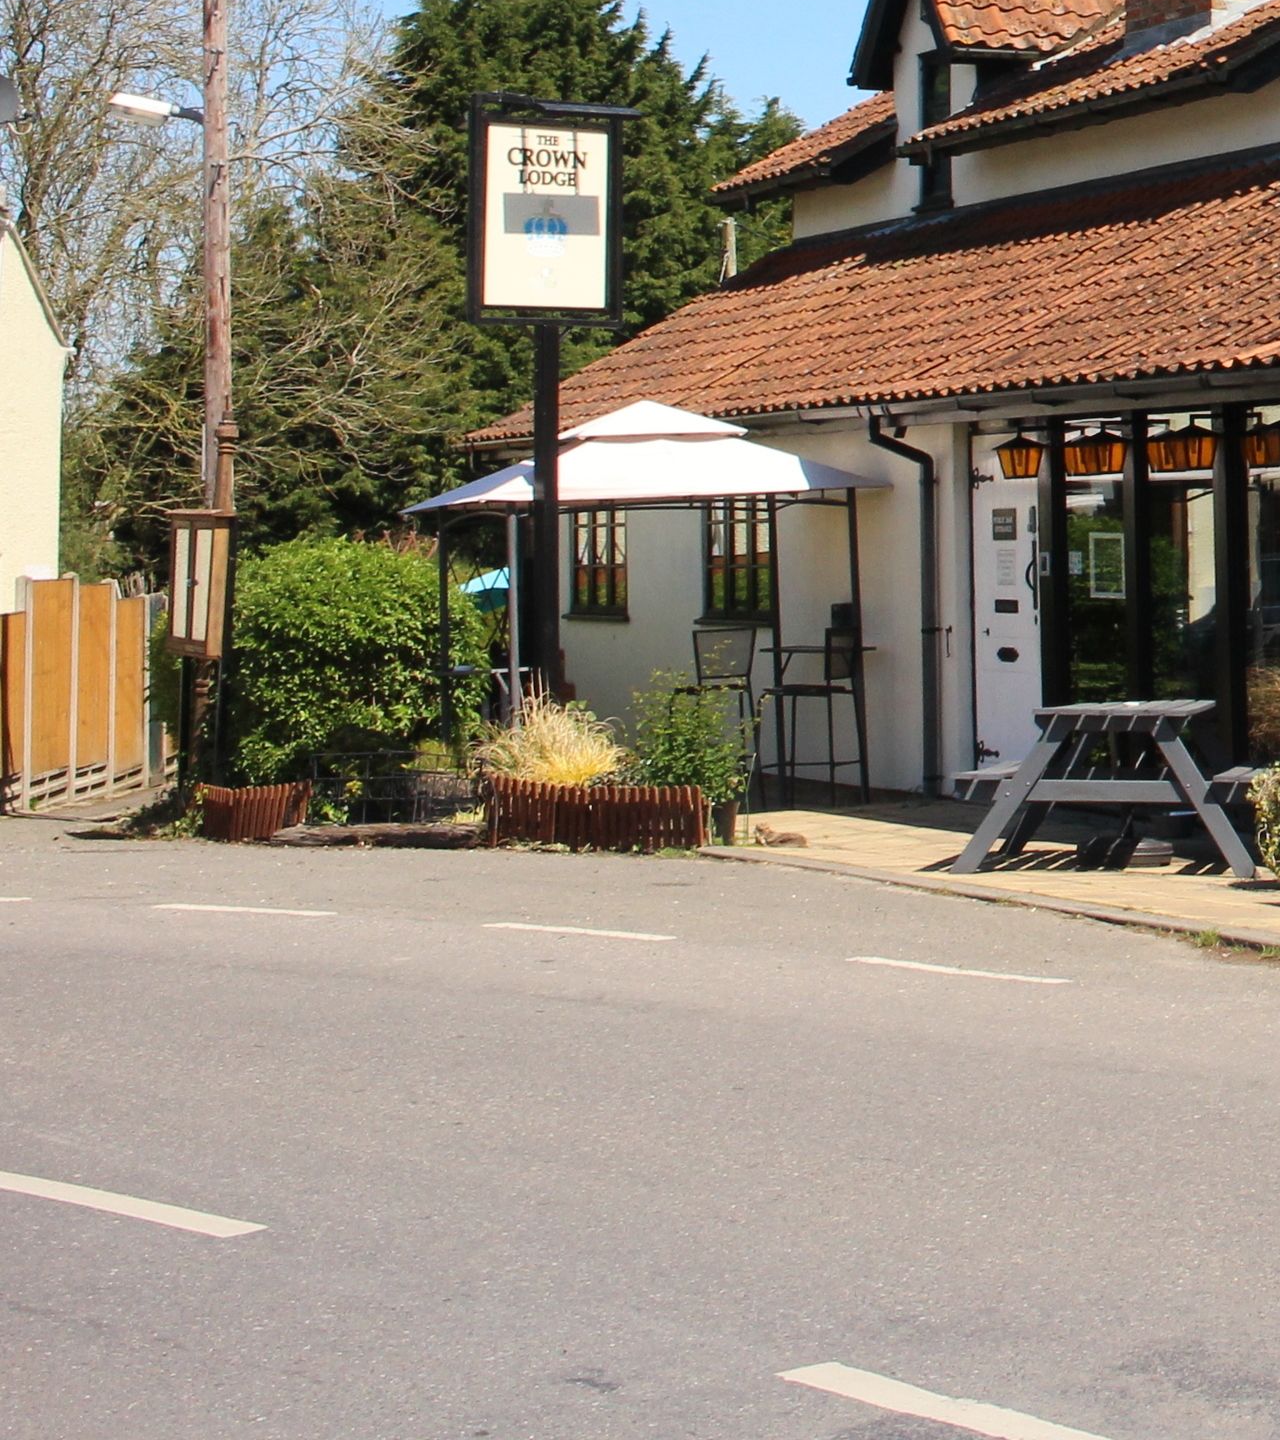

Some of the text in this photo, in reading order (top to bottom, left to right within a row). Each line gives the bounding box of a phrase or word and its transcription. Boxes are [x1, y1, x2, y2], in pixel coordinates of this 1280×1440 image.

[536, 135, 560, 146] THE
[507, 147, 588, 169] CROWN
[518, 169, 578, 187] LODGE
